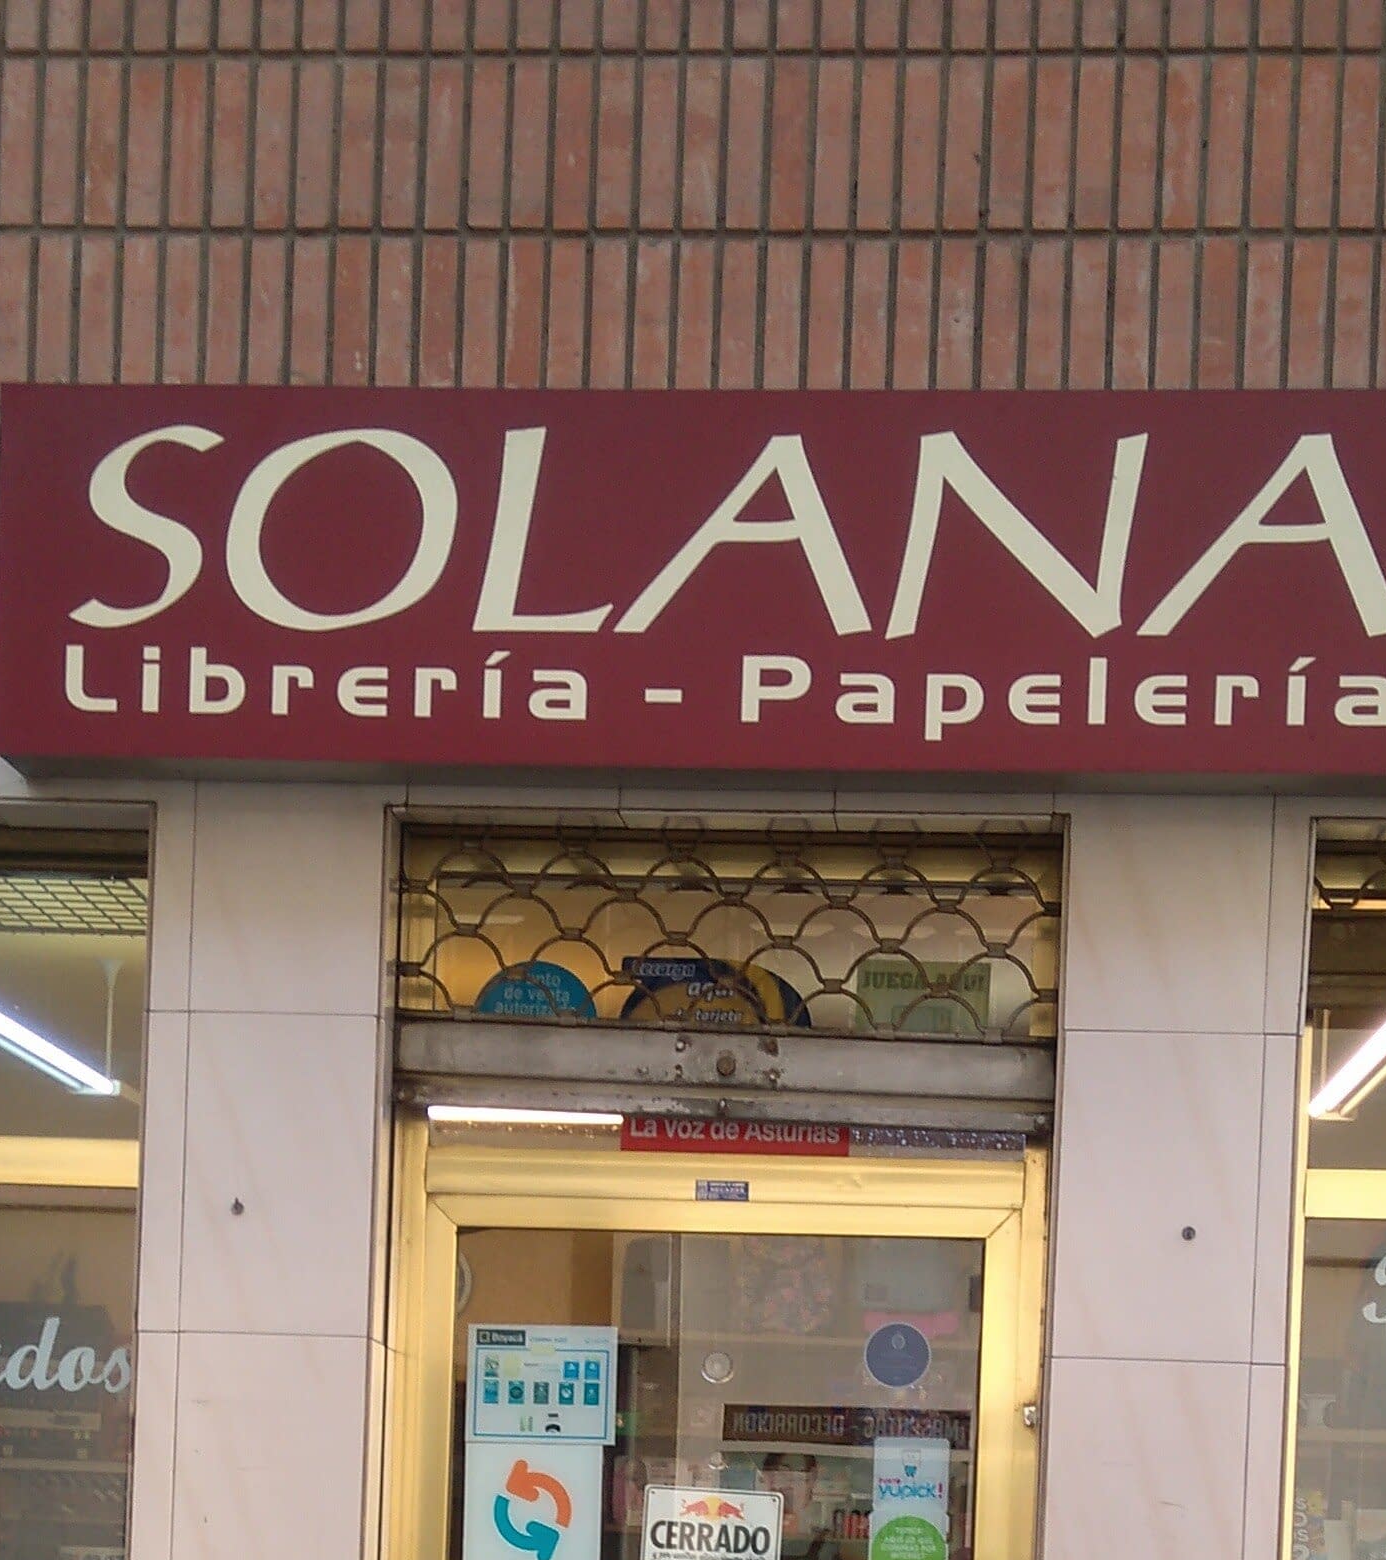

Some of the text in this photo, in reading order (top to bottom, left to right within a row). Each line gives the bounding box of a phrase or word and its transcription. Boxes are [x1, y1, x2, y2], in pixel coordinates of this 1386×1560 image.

[65, 645, 588, 721] Librería
[710, 1119, 739, 1140] de
[650, 1520, 770, 1556] CERRADO
